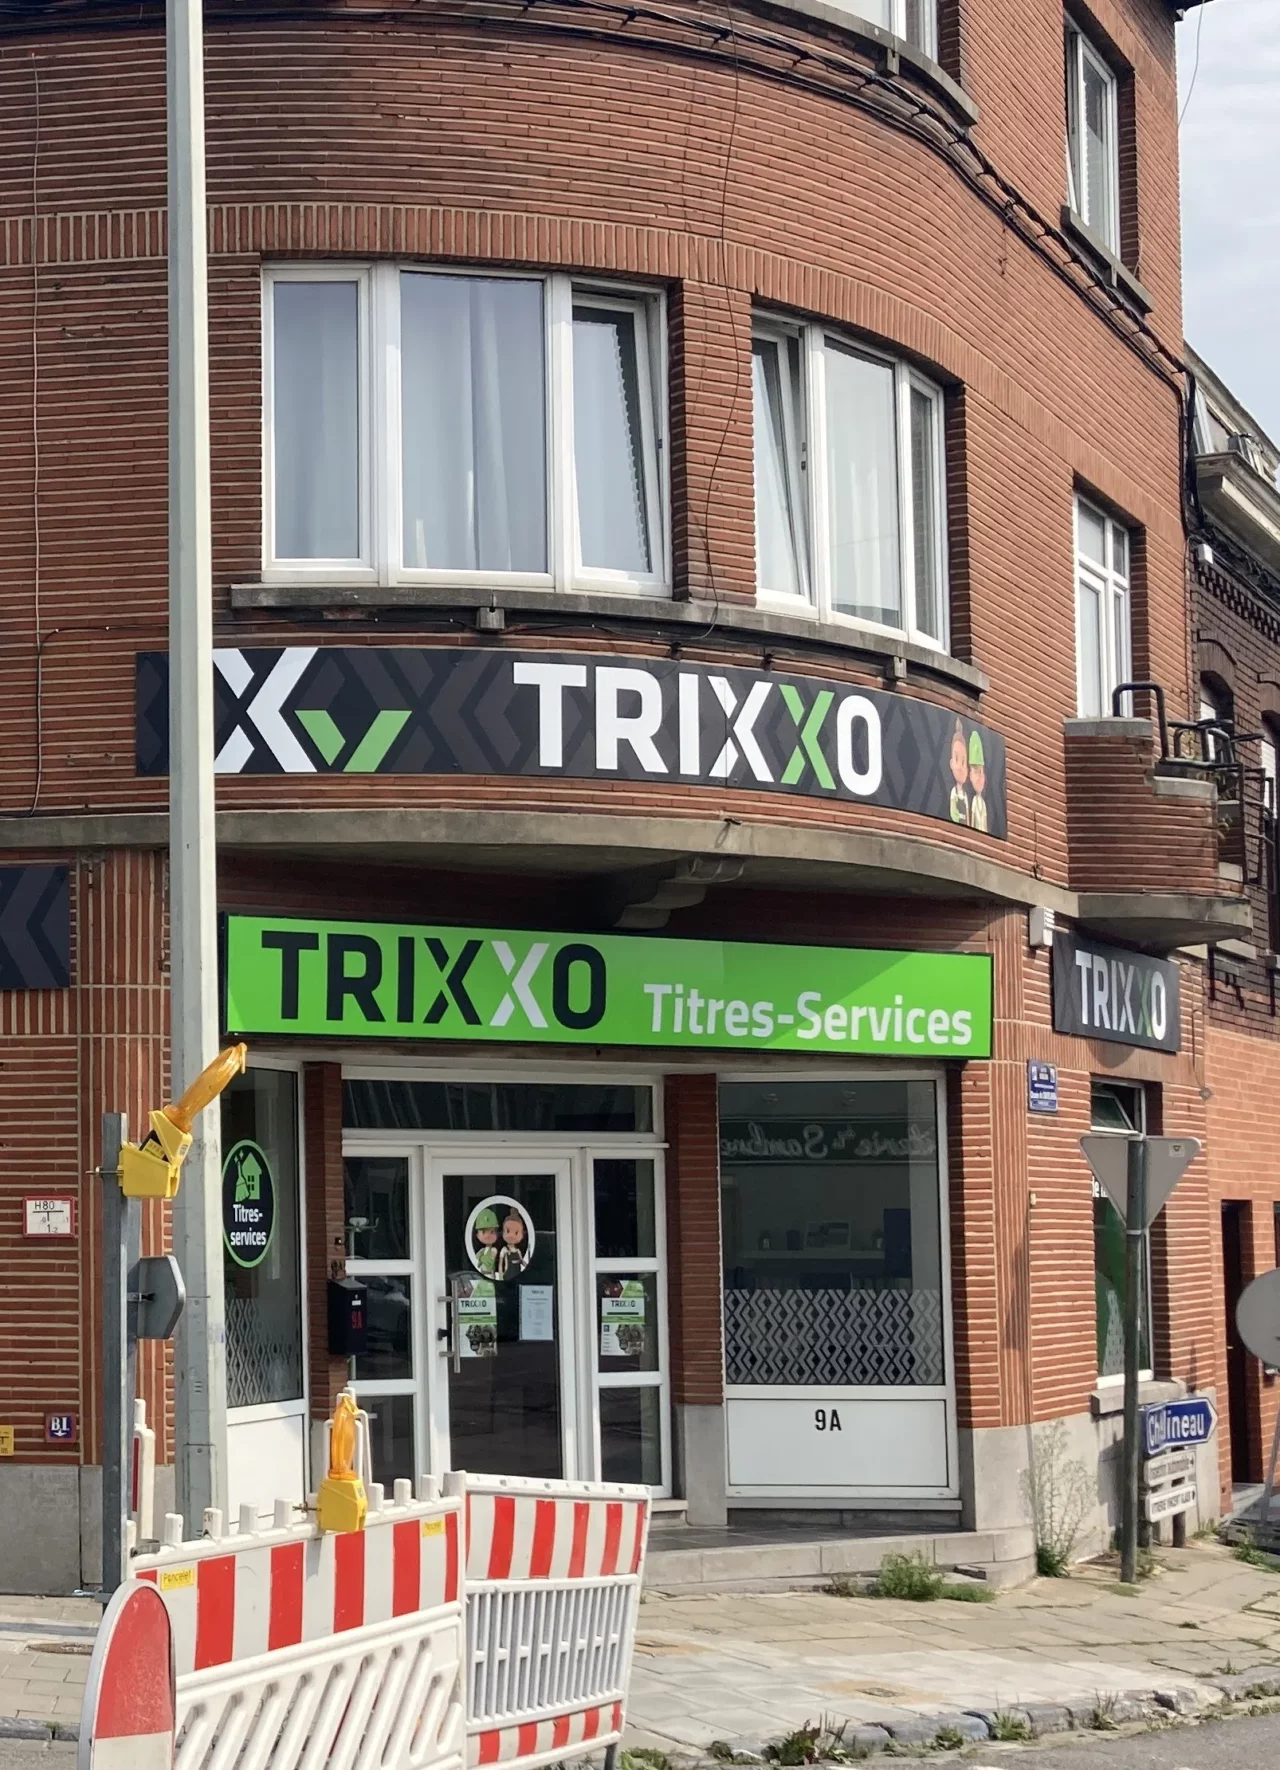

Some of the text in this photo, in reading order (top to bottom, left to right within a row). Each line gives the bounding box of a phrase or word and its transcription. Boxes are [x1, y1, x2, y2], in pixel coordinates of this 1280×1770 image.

[513, 662, 883, 796] TRIXXO
[261, 930, 973, 1046] TRIXXO Titres-Services
[1075, 949, 1167, 1041] TRIXXO
[34, 1200, 55, 1210] H80
[233, 1203, 264, 1223] Titres-
[230, 1227, 267, 1246] services
[351, 1311, 363, 1329] 9A
[815, 1409, 842, 1431] 9A
